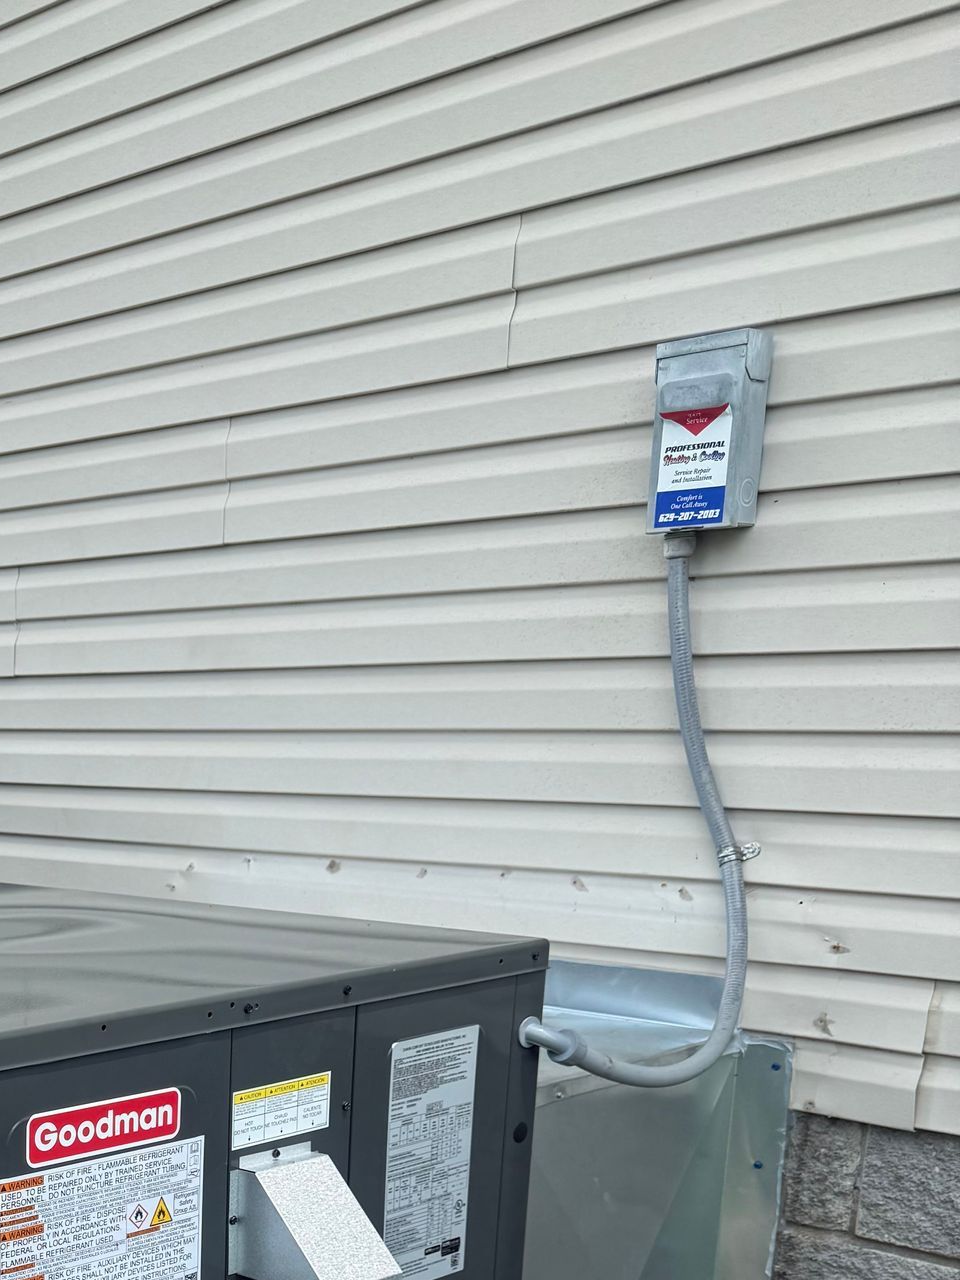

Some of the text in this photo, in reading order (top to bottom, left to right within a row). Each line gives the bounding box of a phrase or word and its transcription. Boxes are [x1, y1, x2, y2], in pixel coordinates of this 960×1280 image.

[686, 417, 708, 425] Service
[664, 441, 725, 453] PROFESSIONAL
[691, 453, 698, 462] &
[671, 475, 713, 484] and Installation
[676, 494, 698, 502] Comfort
[682, 501, 693, 509] Call
[658, 509, 721, 523] 629-207-2003
[274, 1084, 296, 1094] ATTENTION
[243, 1092, 262, 1101] CAUTION
[34, 1104, 173, 1152] Goodman
[250, 1124, 263, 1132] TOUCH
[9, 1176, 43, 1191] WARNING
[48, 1173, 64, 1182] RISK
[66, 1170, 76, 1178] OF
[77, 1167, 92, 1176] FIRE
[98, 1157, 137, 1171] FLAMMABLE
[139, 1147, 183, 1162] REFRIGERANT
[37, 1186, 46, 1194] BE
[49, 1178, 83, 1191] REPAIRED
[85, 1174, 102, 1183] ONLY
[105, 1171, 113, 1179] BY
[116, 1165, 143, 1176] TRAINED
[145, 1158, 172, 1170] SERVICE
[49, 1192, 59, 1200] DO
[61, 1188, 74, 1197] NOT
[77, 1180, 113, 1193] PUNCTURE
[115, 1169, 160, 1184] REFRIGERANT
[174, 1189, 199, 1201] Refrigerant
[179, 1199, 194, 1207] Safety
[9, 1225, 43, 1240] WARNING
[47, 1221, 64, 1230] RISK
[65, 1218, 75, 1226] OF
[77, 1215, 90, 1223] FIRE
[97, 1206, 125, 1218] DISPOSE
[0, 1243, 9, 1251] OF
[13, 1233, 50, 1248] PROPERLY
[61, 1219, 107, 1236] ACCORDANCE
[110, 1215, 126, 1224] WITH
[49, 1237, 70, 1248] LOCAL
[1, 1253, 43, 1269] FLAMMABLE
[46, 1240, 93, 1258] REFRIGERANT
[48, 1271, 64, 1280] RISK
[66, 1268, 75, 1276] OF
[77, 1264, 91, 1274] FIRE
[98, 1254, 130, 1268] AUXILIARY
[133, 1247, 159, 1259] DEVICES
[162, 1241, 182, 1251] WHICH
[183, 1238, 195, 1246] MAY
[82, 1270, 102, 1280] SHALL
[105, 1266, 118, 1275] NOT
[120, 1263, 128, 1271] BE
[130, 1254, 163, 1268] INSTALLED
[173, 1248, 184, 1257] THE
[128, 1264, 155, 1277] DEVICES
[157, 1258, 178, 1269] LISTED
[179, 1254, 192, 1263] FOR
